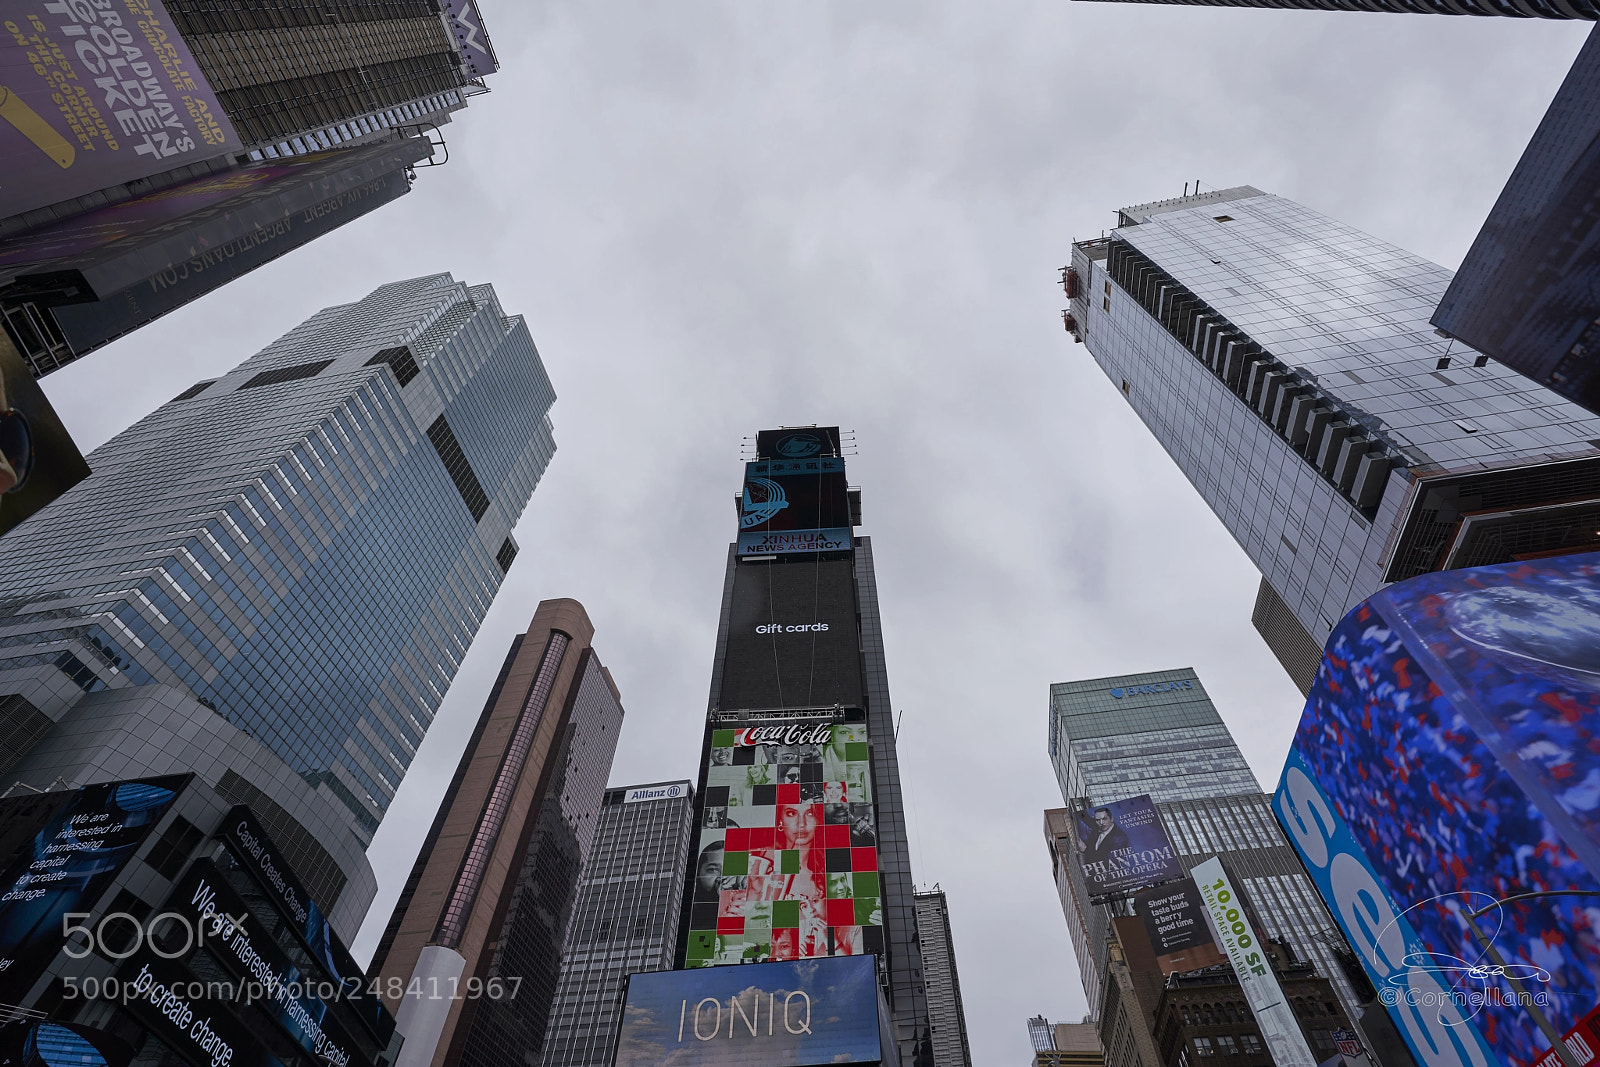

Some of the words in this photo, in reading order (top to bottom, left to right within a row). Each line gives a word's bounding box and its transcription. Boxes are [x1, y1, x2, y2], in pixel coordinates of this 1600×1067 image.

[43, 0, 162, 160] TICKET
[67, 0, 180, 158] GOLDEN
[90, 0, 196, 153] BROADWAY'S
[124, 0, 142, 16] HE
[137, 20, 187, 91] CHOCOLATE
[181, 95, 217, 145] FACTORY
[4, 20, 30, 46] ON
[52, 92, 95, 152] STREET
[27, 14, 46, 33] IS
[43, 37, 79, 81] JUST
[73, 85, 120, 151] AROUND
[29, 34, 56, 67] THE
[52, 69, 100, 138] CORNER
[195, 98, 225, 143] AND
[747, 543, 785, 554] NEWS
[788, 540, 843, 551] AGENCY
[762, 532, 828, 545] XINHUA
[755, 623, 783, 635] Gift
[785, 622, 829, 633] cards
[1126, 680, 1192, 696] BARCLAYS
[631, 788, 666, 801] Allianz
[70, 813, 89, 825] We
[89, 812, 109, 822] are
[1119, 812, 1132, 820] LET
[1133, 807, 1153, 817] YOUR
[1119, 812, 1155, 825] FANTASIES
[55, 822, 110, 840] interested
[110, 822, 123, 833] in
[1125, 818, 1153, 829] UNWIND
[42, 838, 105, 854] harnessing
[1110, 846, 1134, 858] THE
[30, 854, 72, 870] capital
[1082, 845, 1173, 878] PHANTOM
[15, 873, 30, 885] to
[30, 870, 68, 882] create
[236, 820, 263, 860] Capital
[259, 854, 286, 894] Creates
[284, 886, 308, 924] Change
[1093, 873, 1109, 883] OF
[1108, 867, 1132, 880] THE
[1131, 860, 1168, 875] OPERA
[1, 888, 46, 901] change.
[1147, 897, 1168, 908] Show
[1167, 892, 1185, 904] your
[1151, 907, 1171, 917] taste
[1169, 900, 1190, 911] buds
[1160, 911, 1182, 923] berry
[1157, 921, 1176, 935] good
[1175, 918, 1194, 928] time
[1202, 884, 1218, 911] RETAIL
[1213, 911, 1230, 936] SPACE
[1225, 938, 1251, 983] AVAILABLE
[1212, 878, 1252, 949] 10,000
[1245, 952, 1267, 977] SF
[191, 879, 216, 919] We
[212, 911, 234, 940] are
[230, 926, 279, 993] interested
[275, 977, 290, 1005] in
[285, 990, 327, 1056] harnessing
[323, 1039, 351, 1067] capital
[133, 963, 151, 995] to
[150, 984, 192, 1030] create
[678, 990, 813, 1044] IONIQ
[1338, 1040, 1361, 1056] NFL
